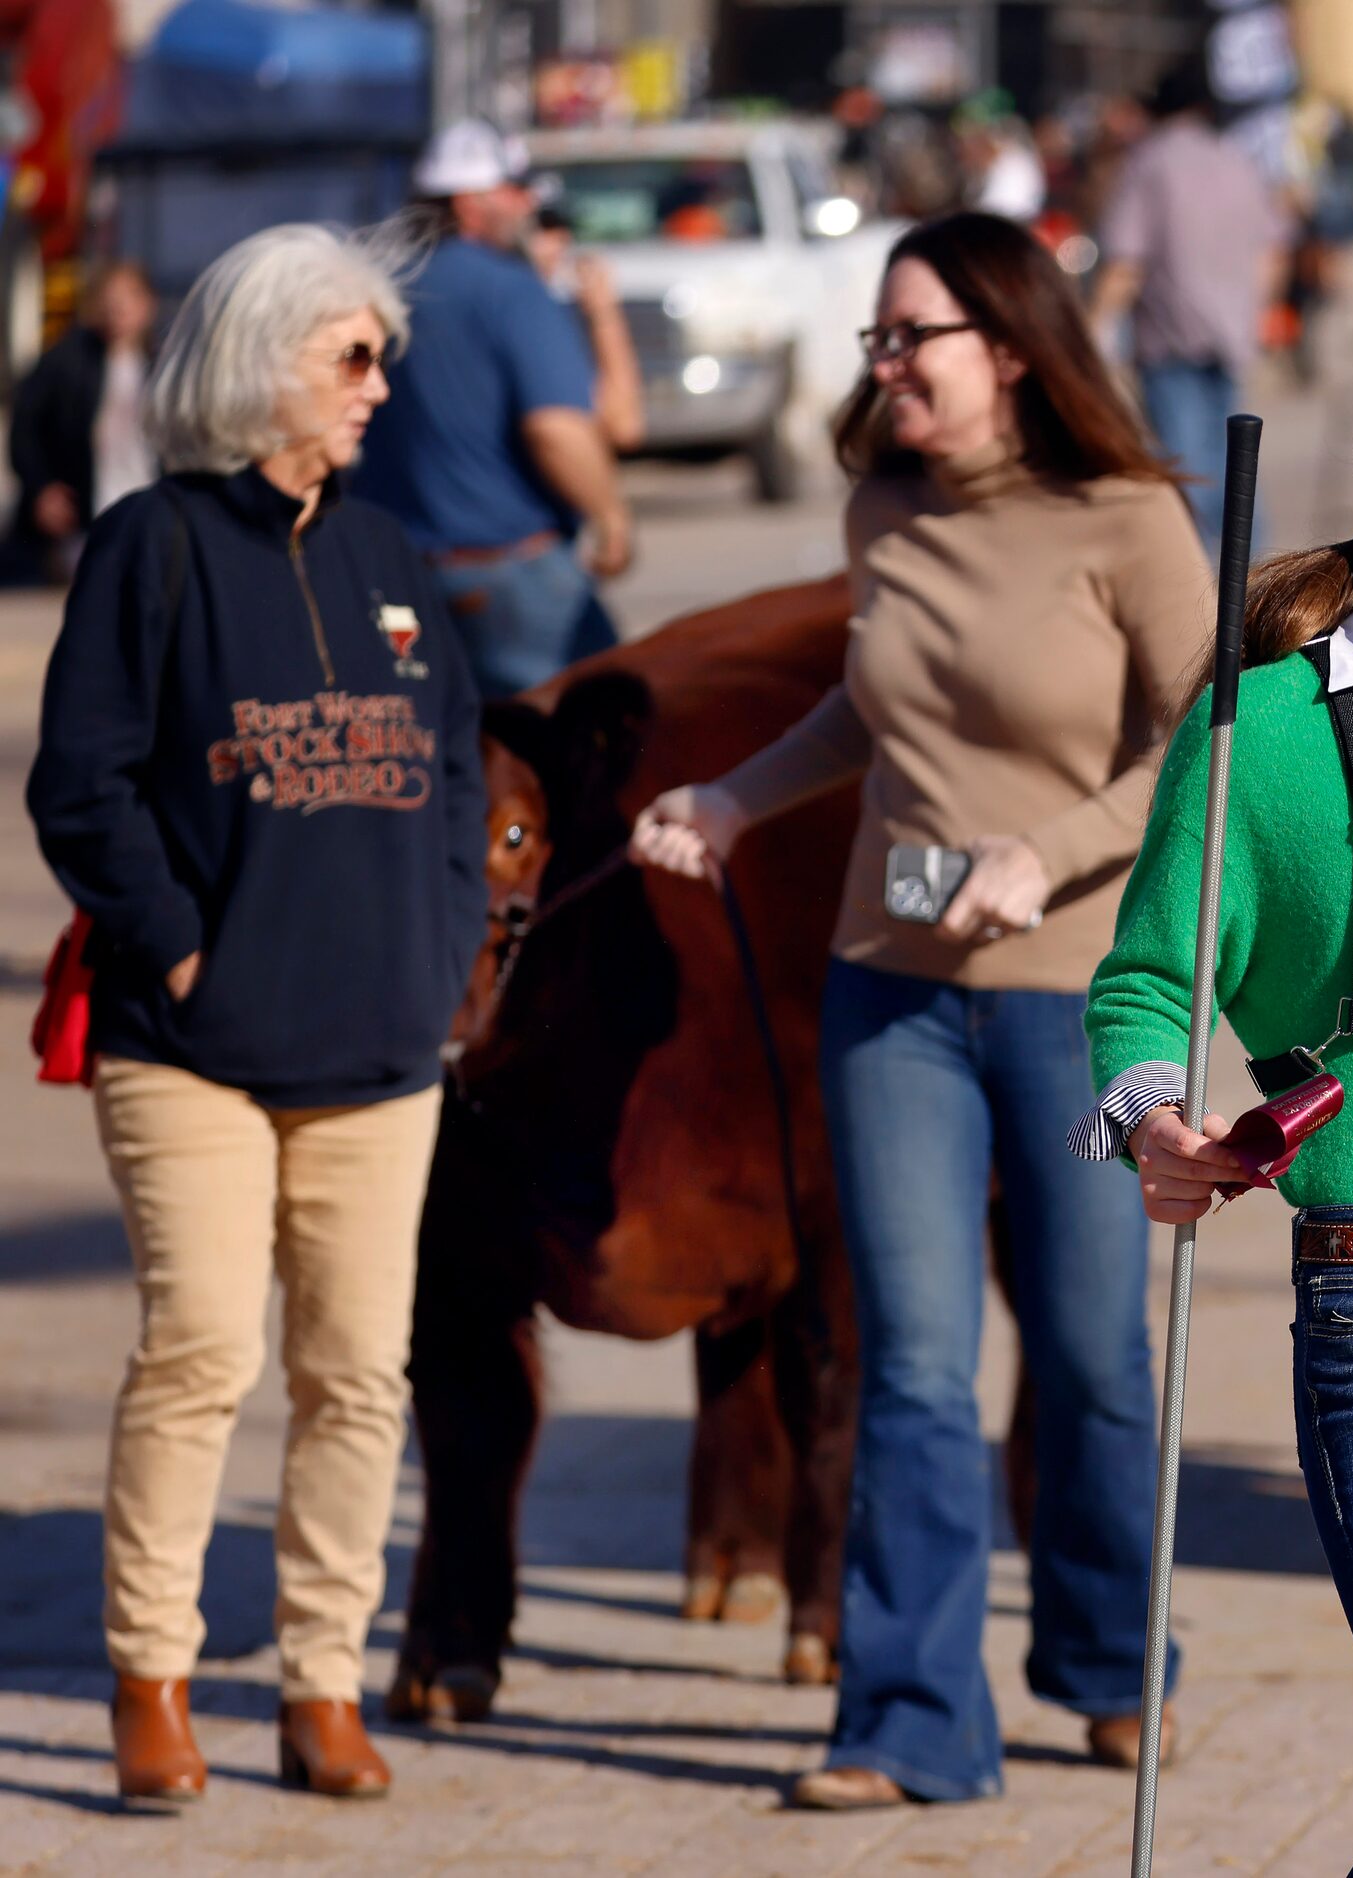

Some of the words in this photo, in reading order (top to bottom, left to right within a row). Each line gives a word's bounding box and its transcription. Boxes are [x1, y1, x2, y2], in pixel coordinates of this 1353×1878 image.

[232, 698, 313, 738] FORT
[207, 730, 343, 785] STOCK
[272, 759, 405, 809] RODEO
